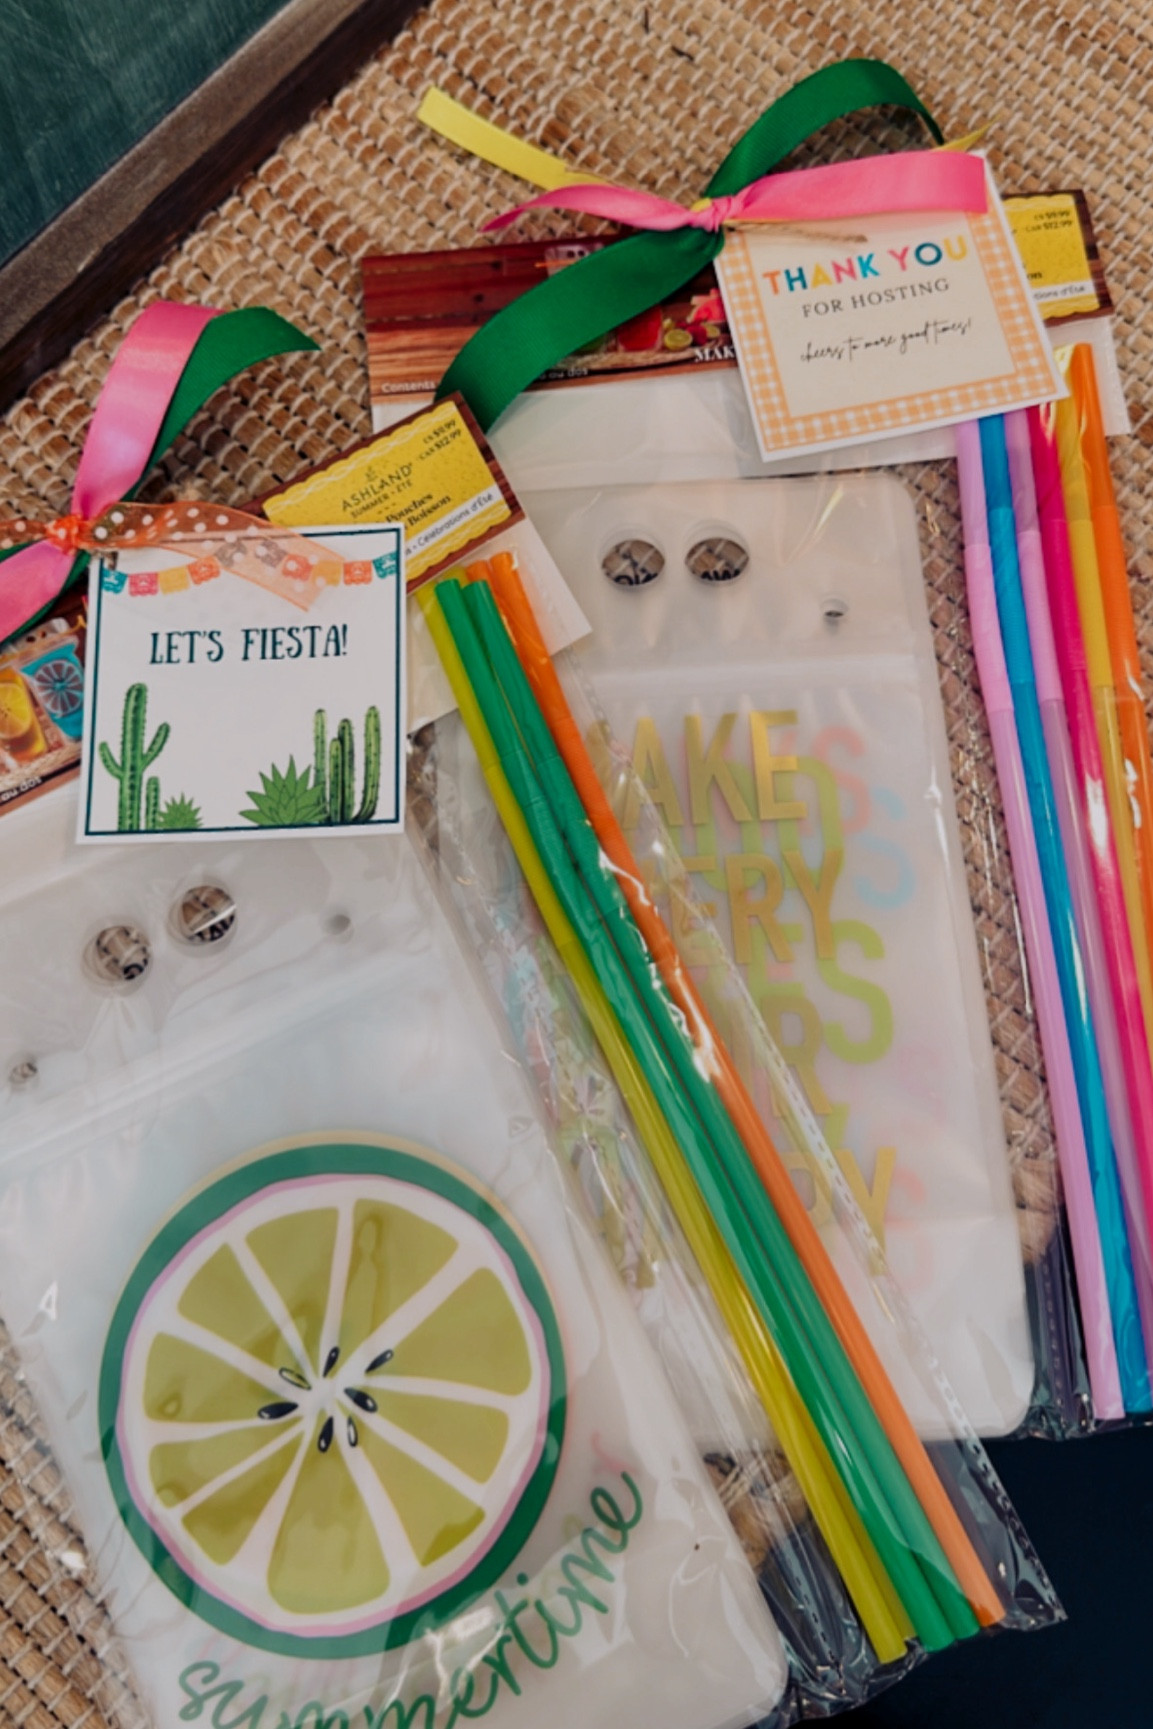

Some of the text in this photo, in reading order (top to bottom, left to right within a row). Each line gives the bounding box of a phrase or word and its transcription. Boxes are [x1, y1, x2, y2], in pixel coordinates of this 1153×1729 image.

[762, 234, 968, 295] THANK YOU
[802, 278, 950, 317] FOR HOSTING
[694, 346, 737, 363] MAK
[800, 317, 972, 363] cheers to more good times!
[381, 381, 437, 393] Contents
[350, 492, 390, 519] SUMMER
[386, 493, 433, 523] Pouches
[407, 495, 452, 526] Boisson
[149, 623, 348, 665] LET'S FIESTA!
